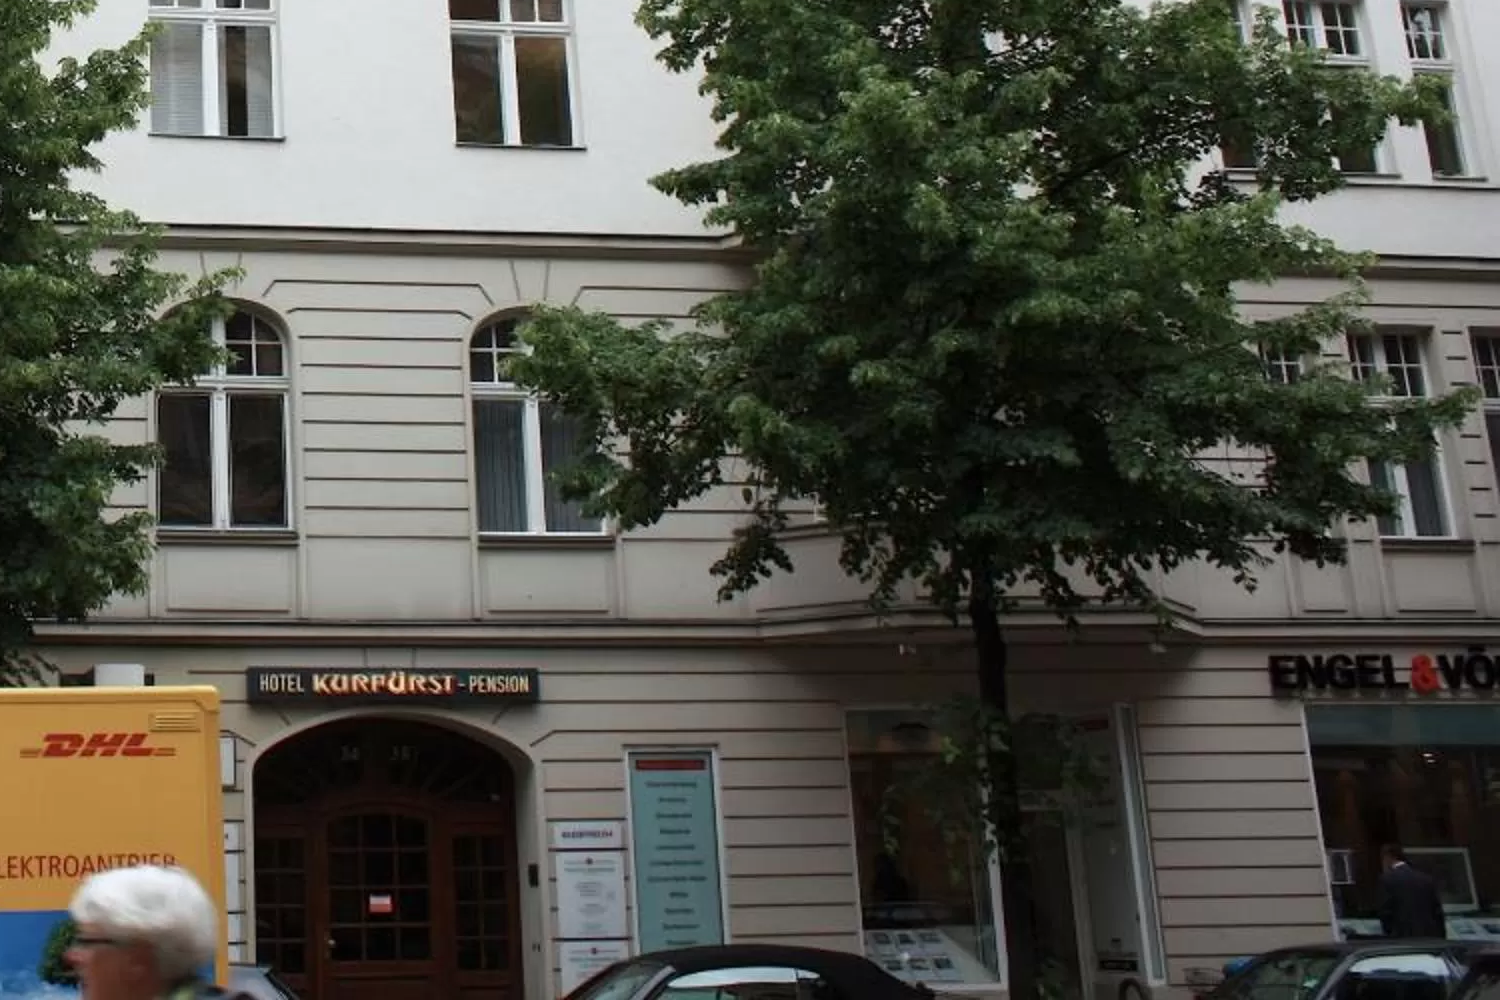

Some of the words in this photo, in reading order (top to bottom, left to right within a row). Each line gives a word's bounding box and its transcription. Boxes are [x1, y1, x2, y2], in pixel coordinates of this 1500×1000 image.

[259, 672, 305, 693] HOTEL
[312, 669, 454, 695] KURFÜRST
[468, 674, 530, 694] PENSION
[1268, 645, 1500, 693] ENGEL&VÖ
[42, 733, 153, 757] DHL
